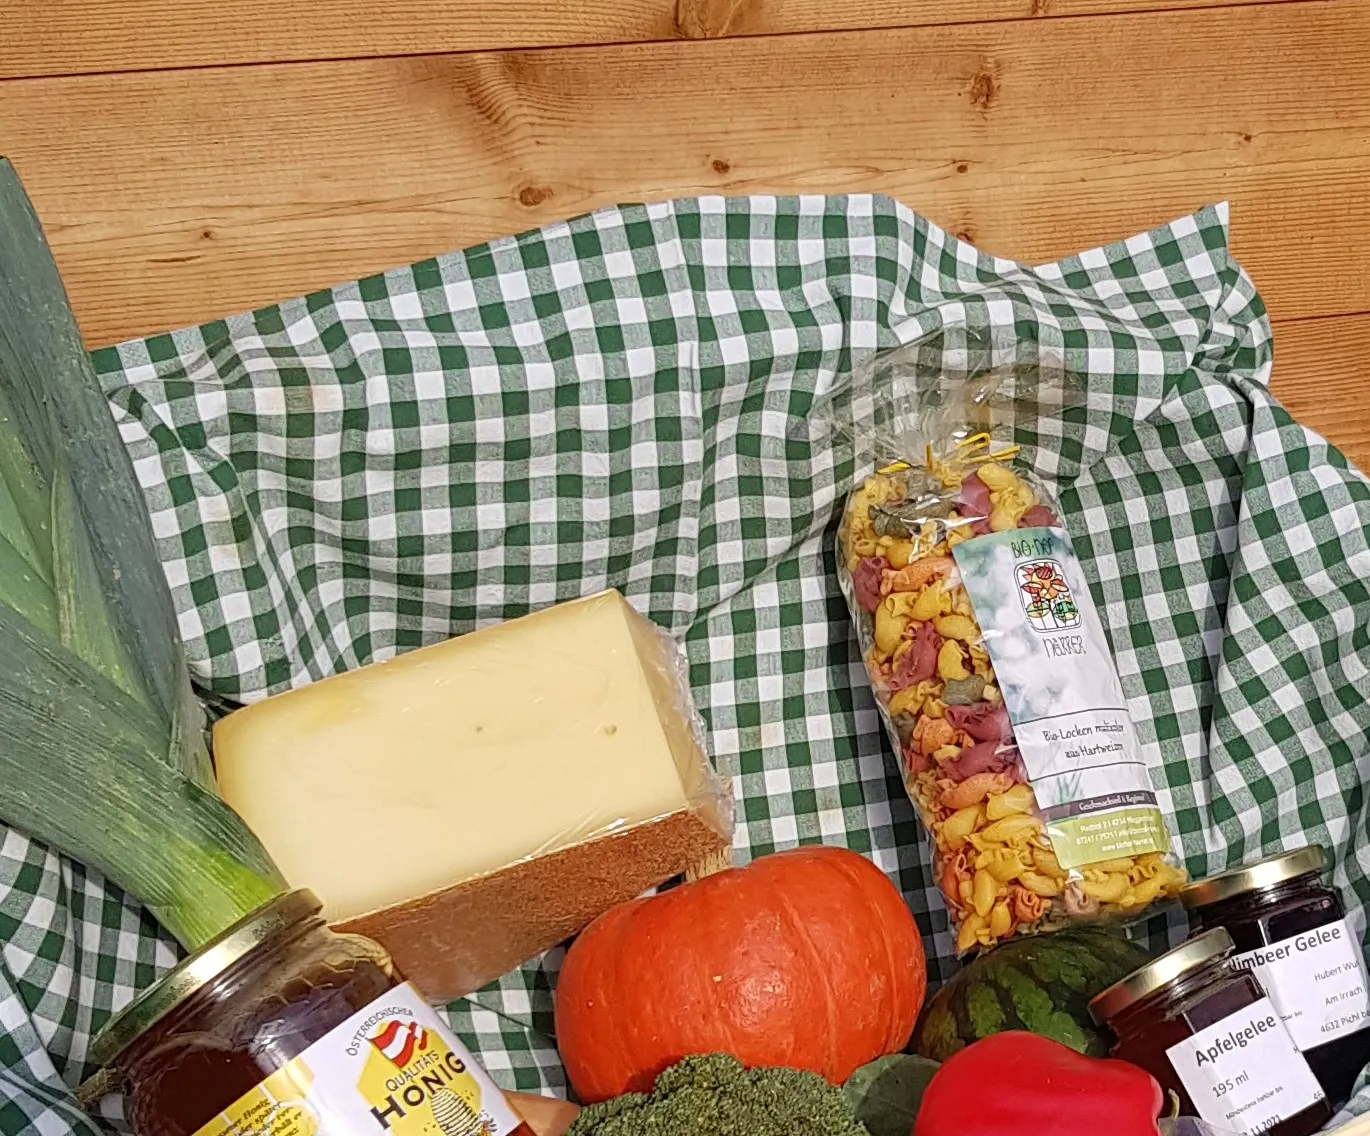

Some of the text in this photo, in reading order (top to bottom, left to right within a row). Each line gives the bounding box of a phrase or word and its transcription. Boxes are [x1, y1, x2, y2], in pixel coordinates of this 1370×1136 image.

[1295, 926, 1342, 952] Gelee
[1314, 963, 1343, 981] Hubert
[345, 1005, 415, 1057] ÖSTERREICHISCHER
[1195, 1013, 1277, 1067] Apfelgelee
[371, 1051, 466, 1129] HONIG
[385, 1049, 440, 1091] QUALITÄTS
[1212, 1070, 1250, 1098] 195 ml
